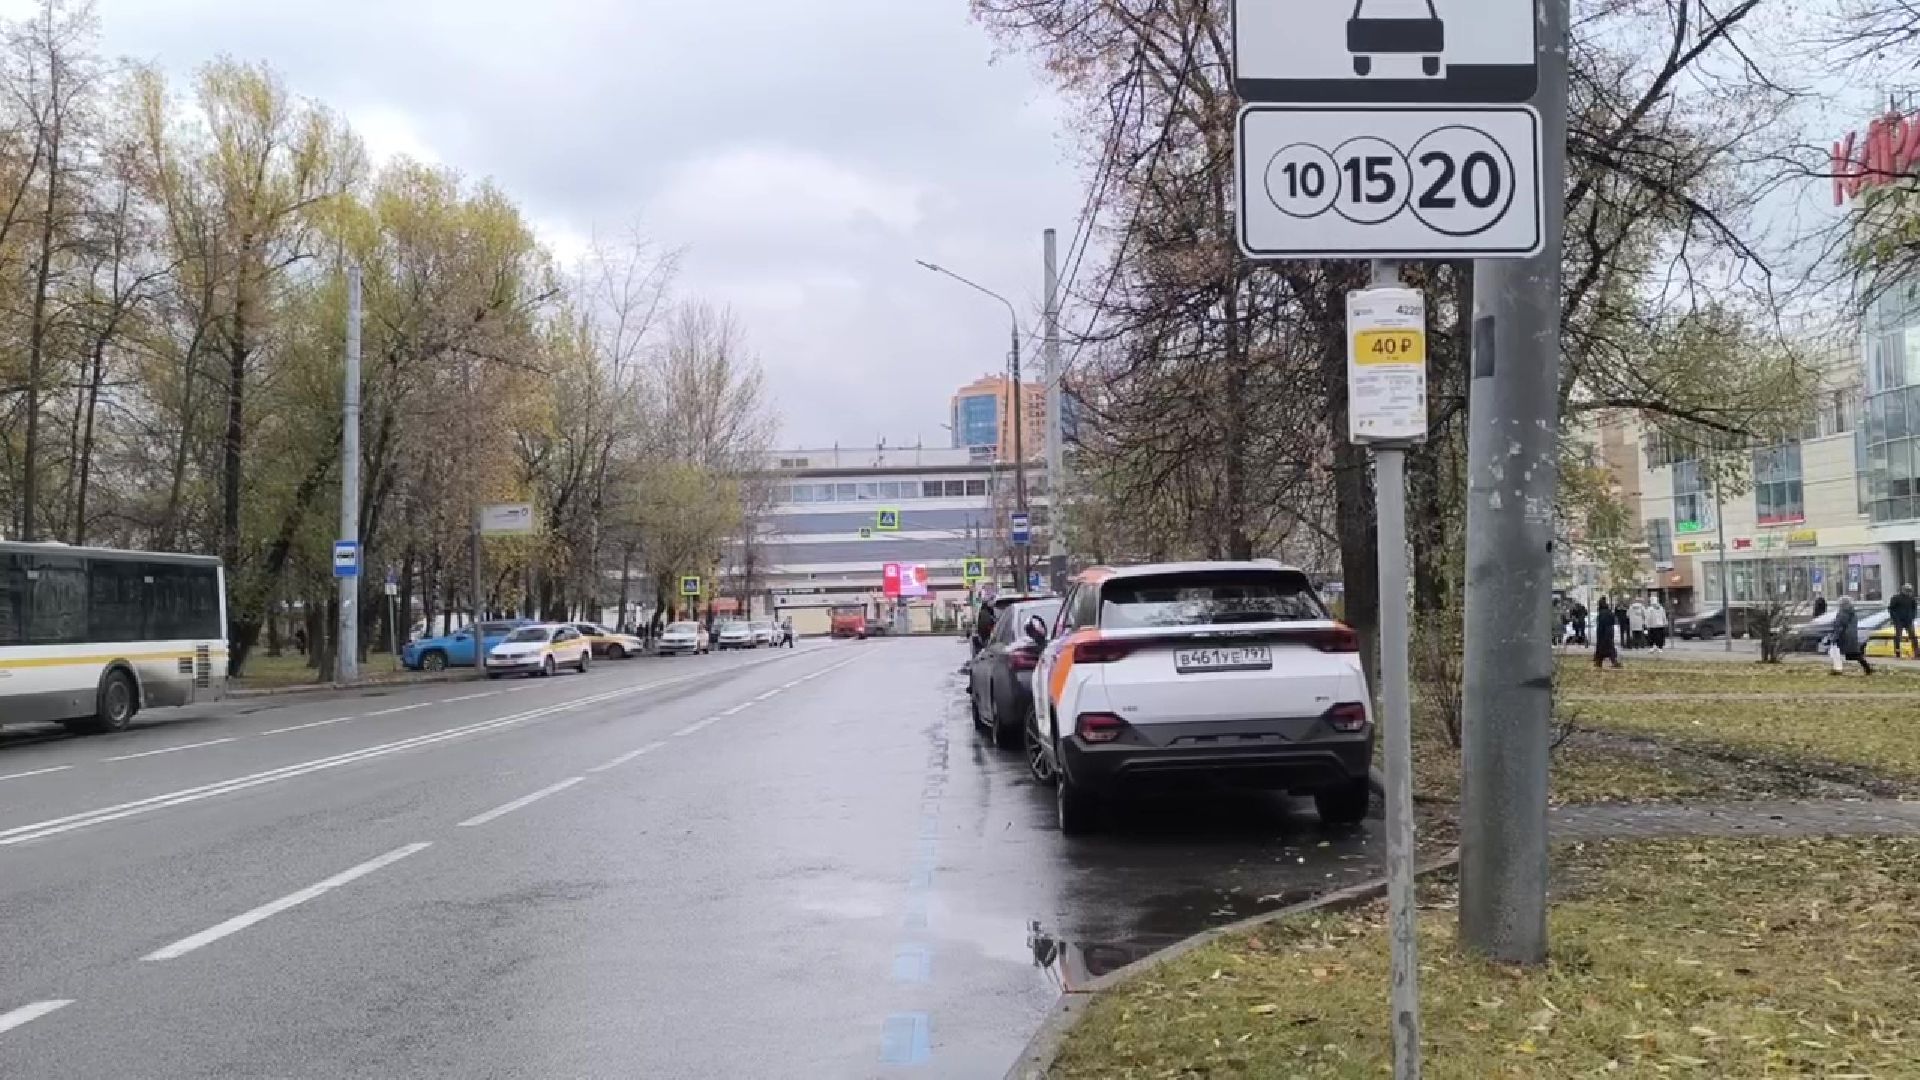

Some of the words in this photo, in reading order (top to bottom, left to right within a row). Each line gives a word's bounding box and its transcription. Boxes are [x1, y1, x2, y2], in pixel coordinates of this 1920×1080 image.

[1282, 162, 1325, 198] 10
[1343, 156, 1396, 204] 15
[1418, 151, 1501, 209] 20
[1371, 338, 1397, 355] 40
